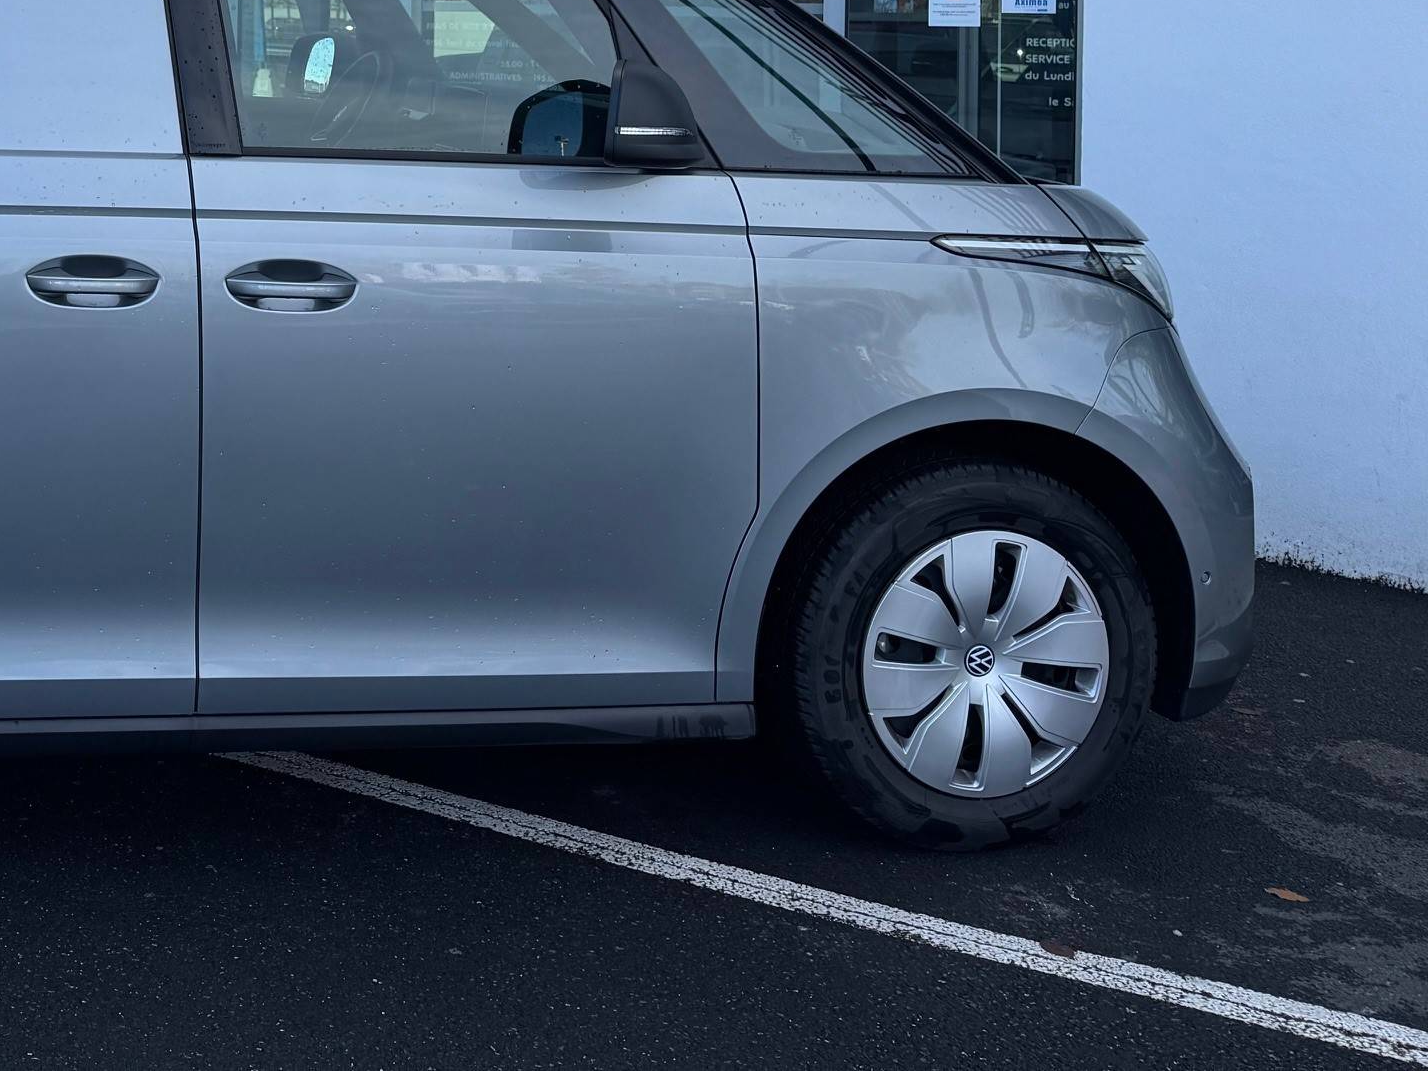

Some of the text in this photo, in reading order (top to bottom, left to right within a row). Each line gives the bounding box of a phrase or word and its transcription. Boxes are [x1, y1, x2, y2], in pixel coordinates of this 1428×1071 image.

[1025, 54, 1070, 64] SERVICE
[1025, 71, 1039, 80] du
[1048, 96, 1074, 107] le S
